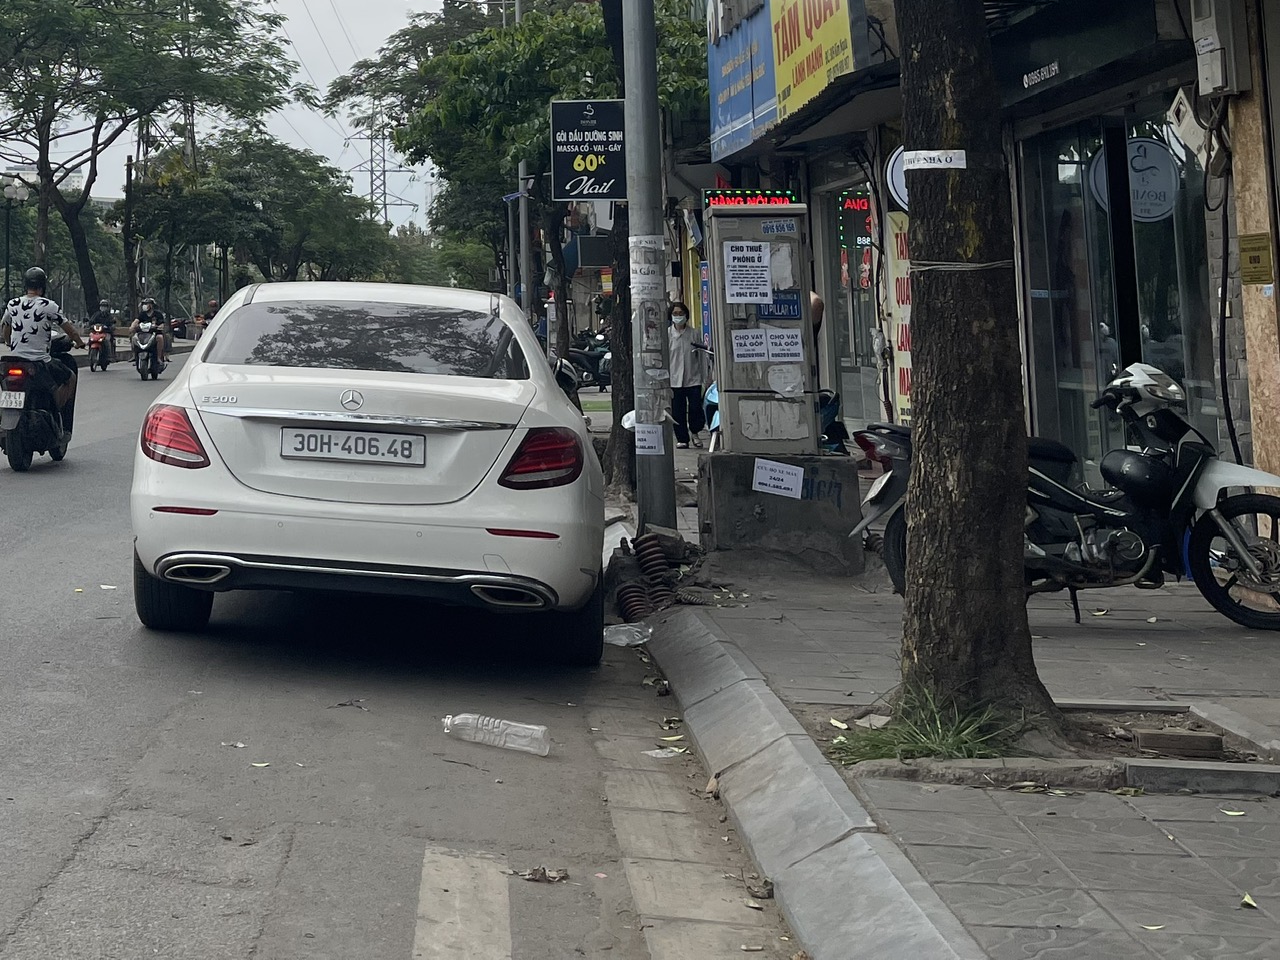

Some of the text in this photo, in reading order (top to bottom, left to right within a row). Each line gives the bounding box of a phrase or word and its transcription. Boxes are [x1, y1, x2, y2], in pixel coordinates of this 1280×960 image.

[608, 131, 623, 141] SINH
[556, 144, 579, 152] MASSA
[565, 175, 616, 196] Nail
[709, 194, 744, 205] HÀNG
[730, 244, 763, 253] CHO THUÊ
[732, 254, 755, 263] PHÒNG
[895, 266, 911, 309] QUẤ
[293, 433, 413, 459] 30H-406.48
